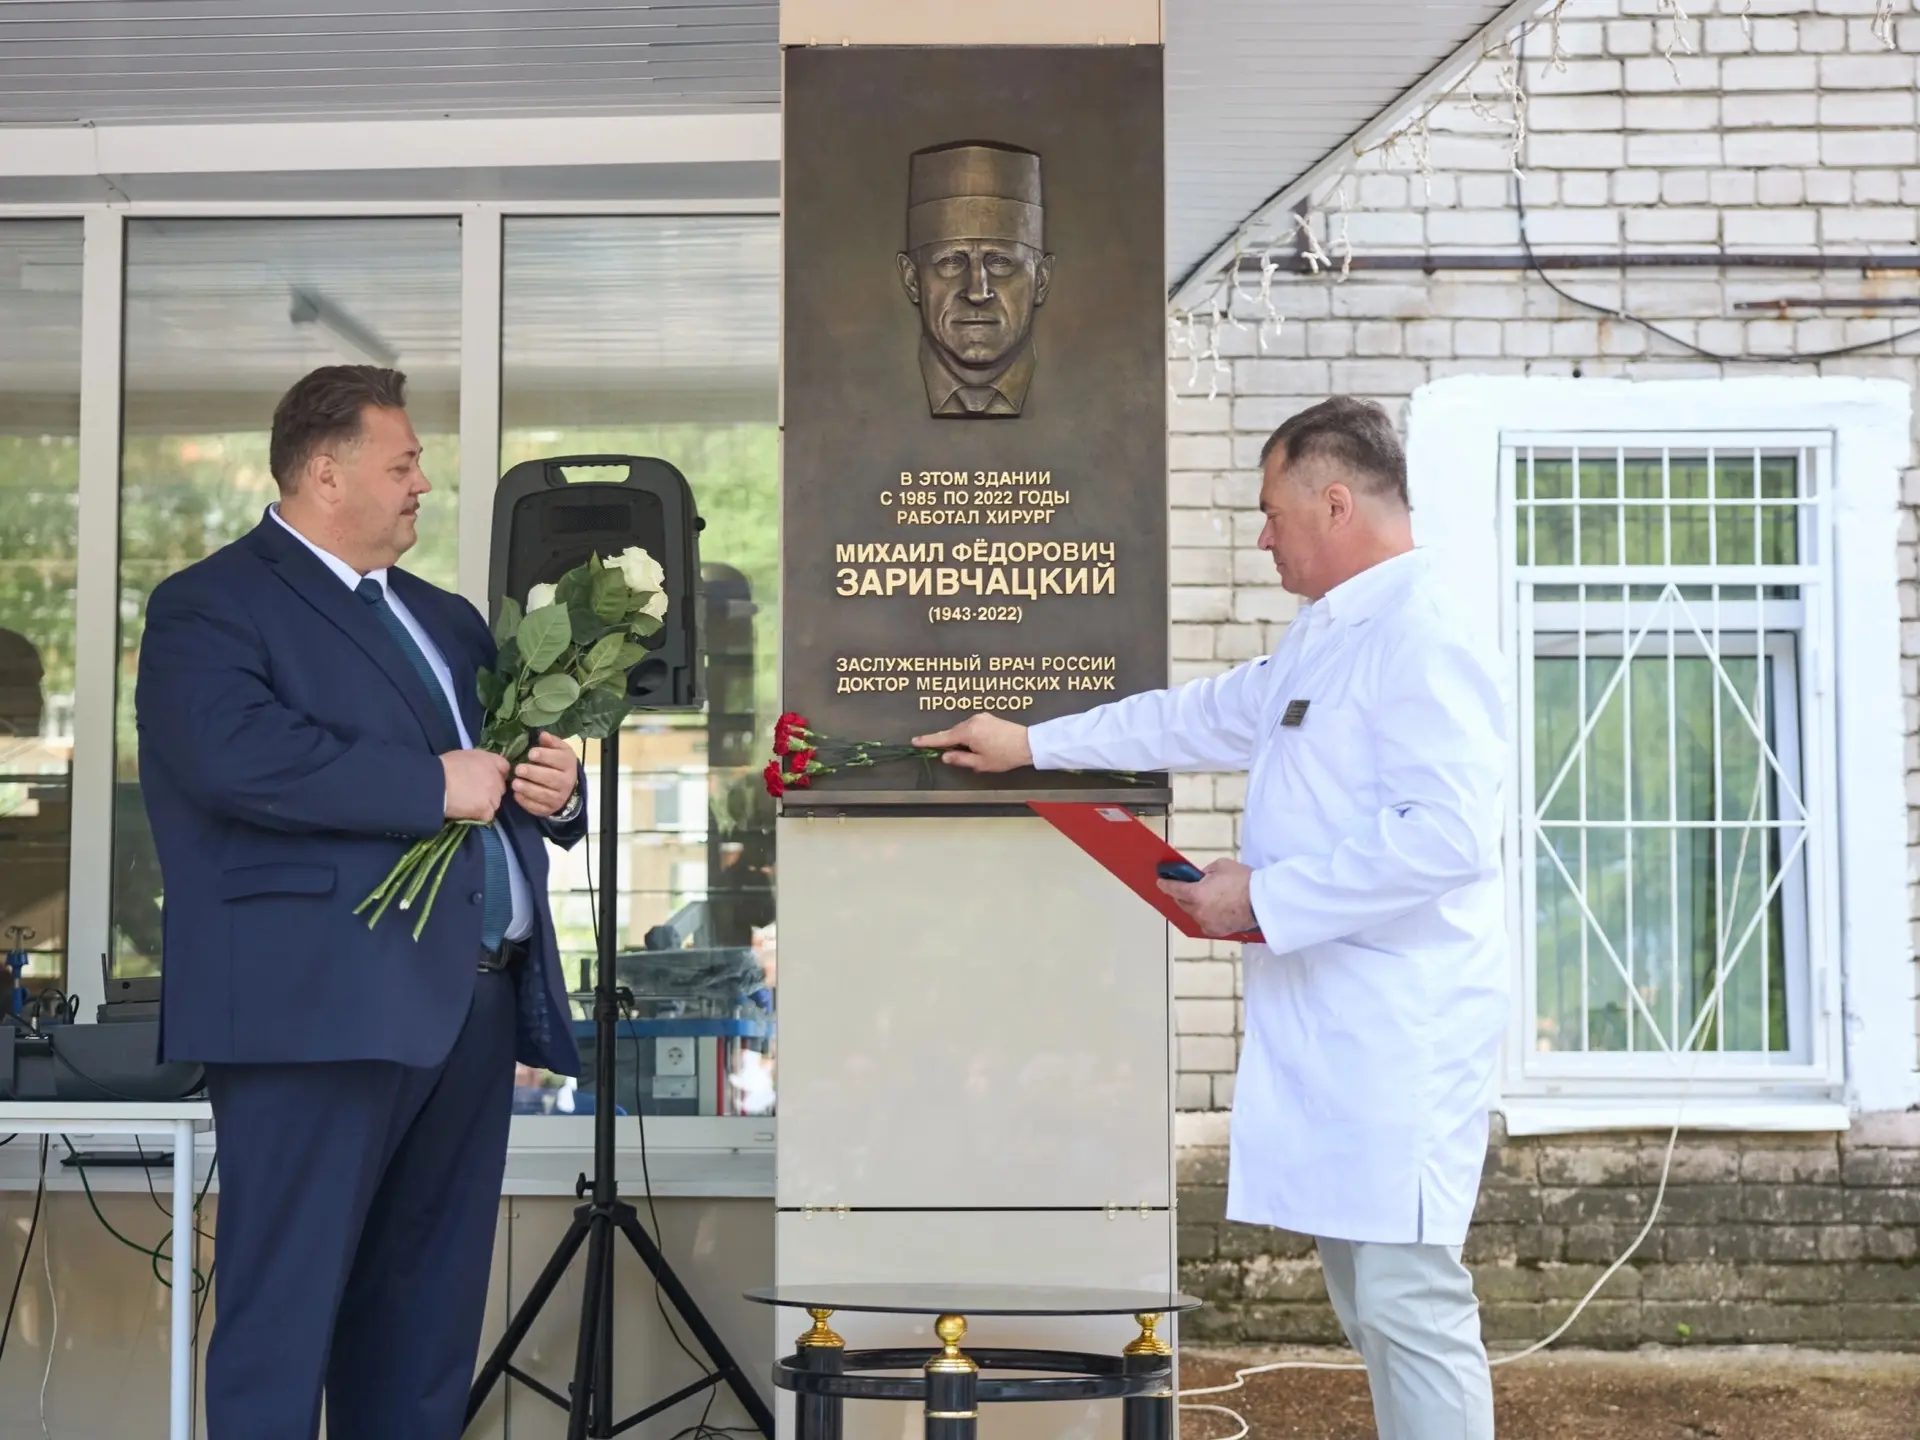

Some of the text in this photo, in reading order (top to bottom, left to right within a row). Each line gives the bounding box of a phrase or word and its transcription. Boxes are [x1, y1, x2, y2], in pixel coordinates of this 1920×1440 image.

[900, 470, 1051, 488] В ЭТОМ ЗДАНИИ
[880, 490, 1070, 507] С 1985 ПО 2022 ГОДЫ
[897, 509, 1056, 525] РАБОТАЛ ХИРУРГ
[835, 538, 1115, 566] МИХАИЛ ФЁДОРОВИЧ
[835, 562, 1116, 601] ЗАРИВЧАЦКИЙ
[928, 606, 1023, 623] (1943-2022)
[836, 654, 1116, 672] ЗАСЛУЖЕННЫЙ ВРАЧ РОССИИ
[836, 676, 1116, 694] ДОКТОР МЕДИЦИНСКИХ НАУК
[919, 696, 1034, 711] ПРОФЕССОР
